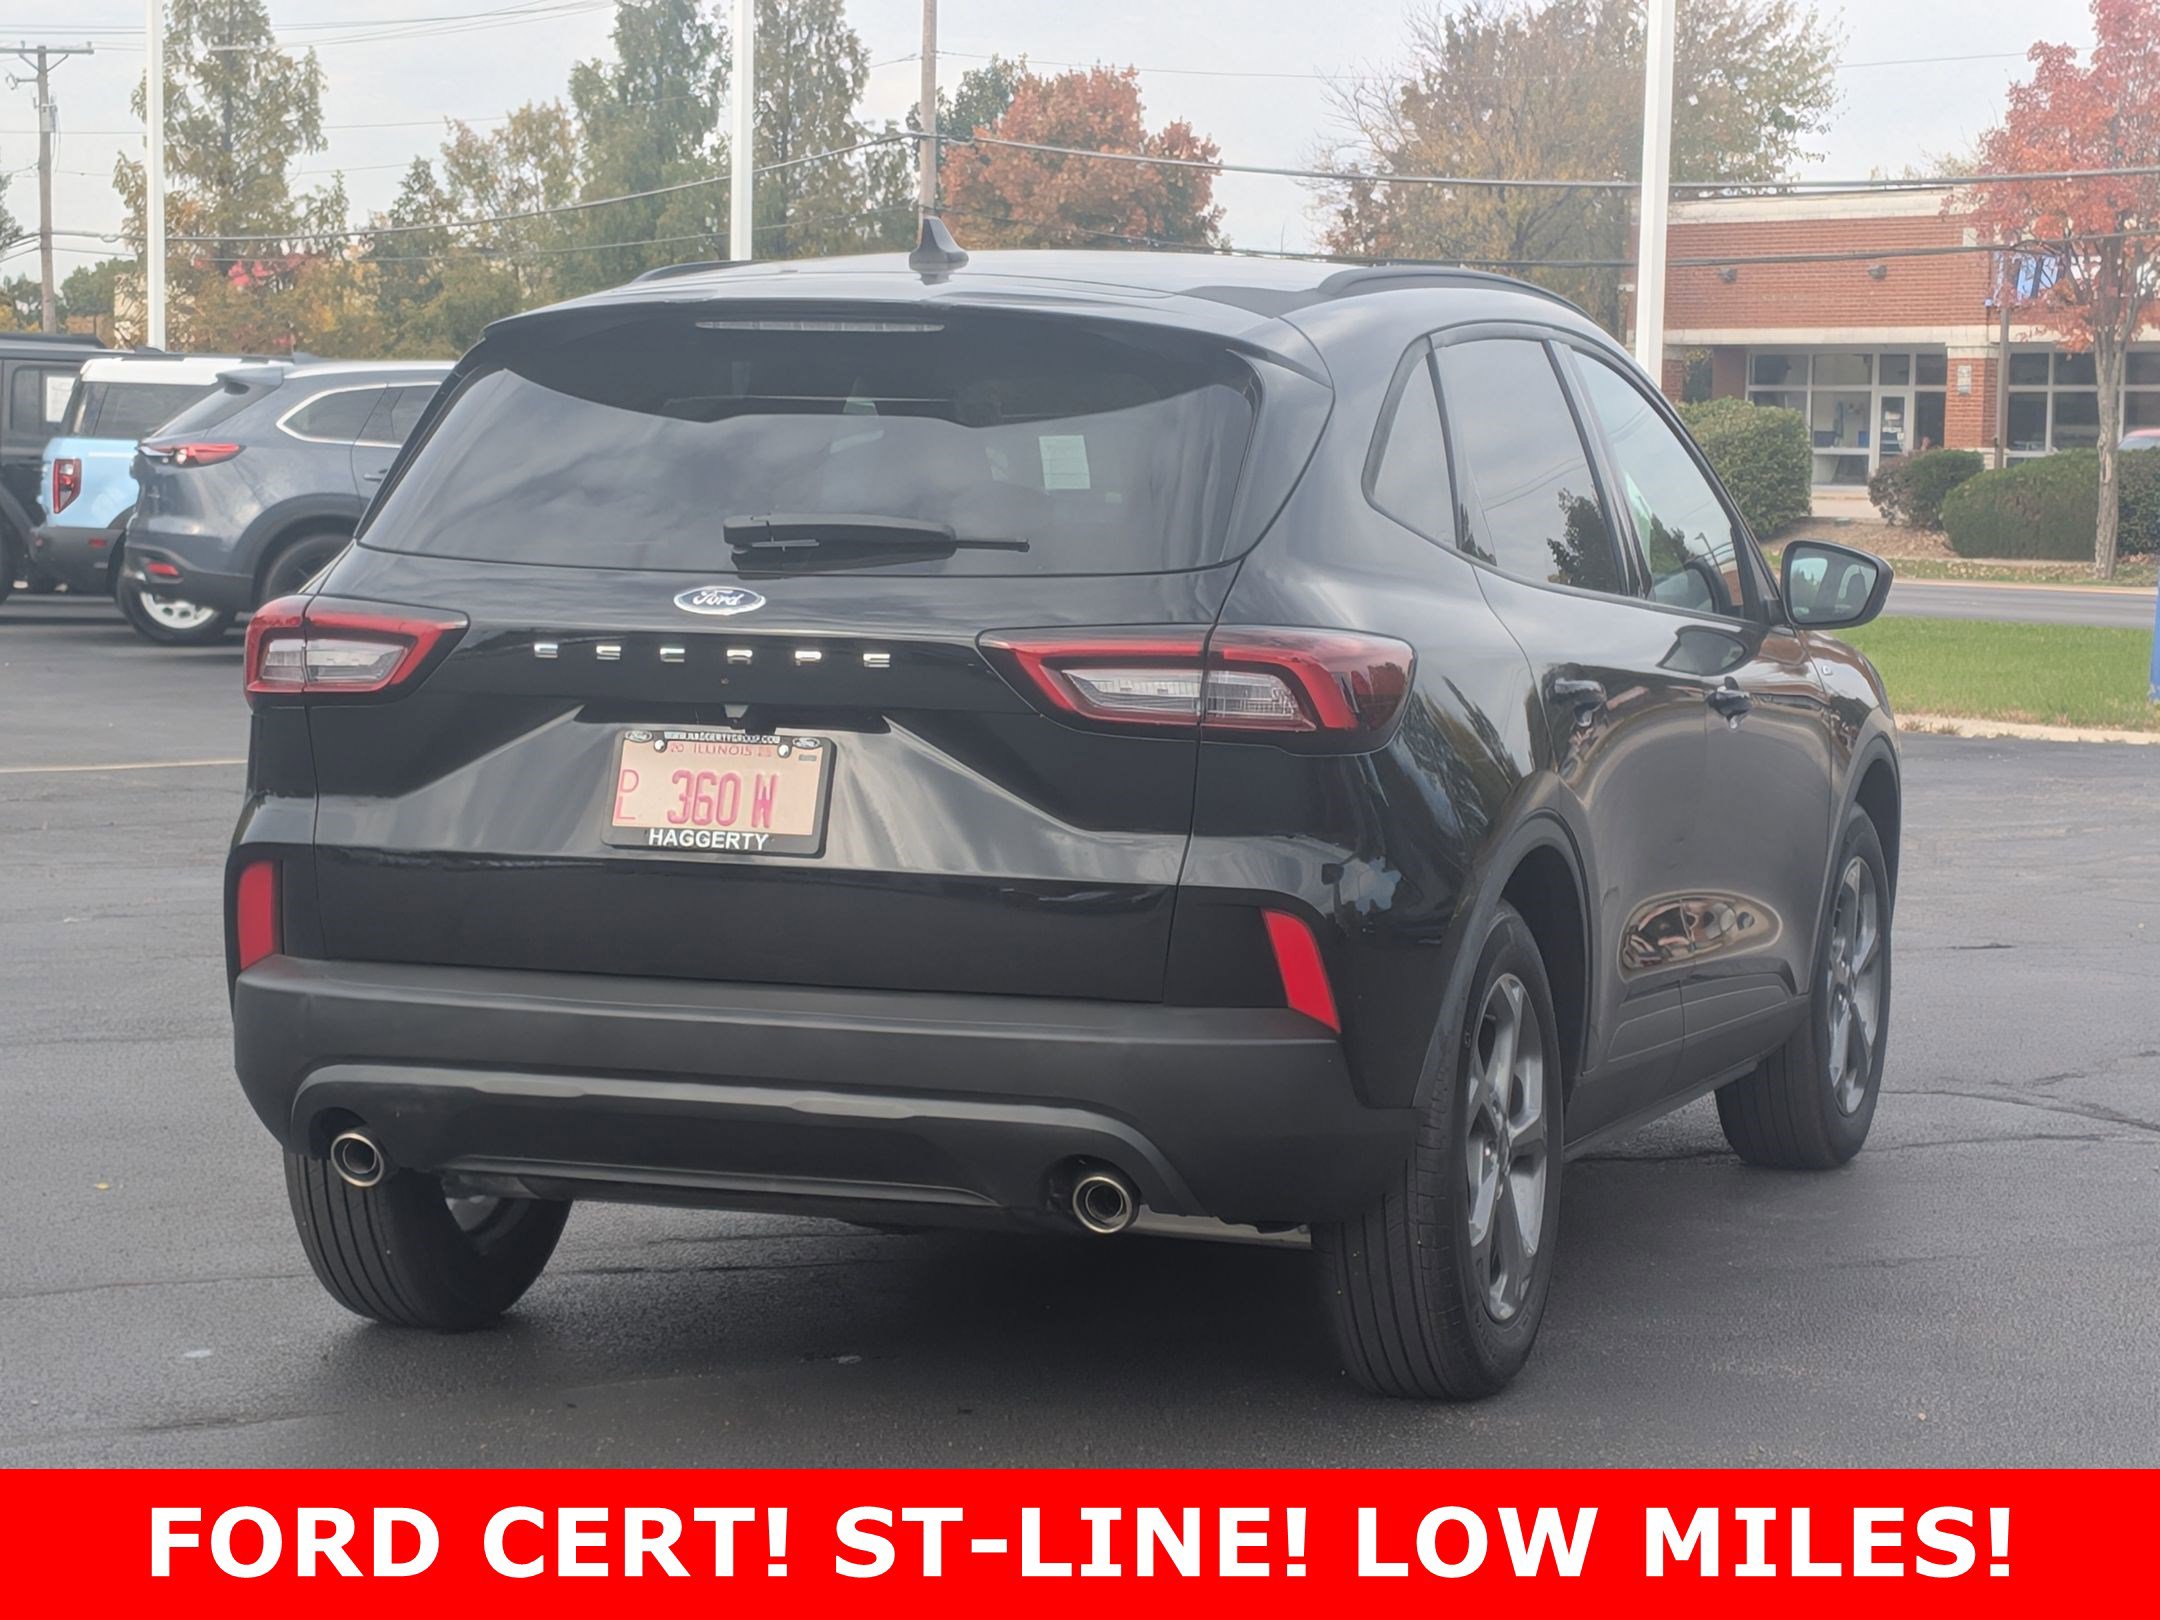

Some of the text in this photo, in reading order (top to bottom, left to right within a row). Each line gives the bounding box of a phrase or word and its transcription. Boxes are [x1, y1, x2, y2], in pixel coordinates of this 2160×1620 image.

[692, 589, 745, 606] Ford
[533, 642, 892, 669] ESCAPE
[693, 744, 752, 757] ILLINOIS
[667, 769, 779, 829] 360 W
[648, 828, 769, 850] HAGGERTY
